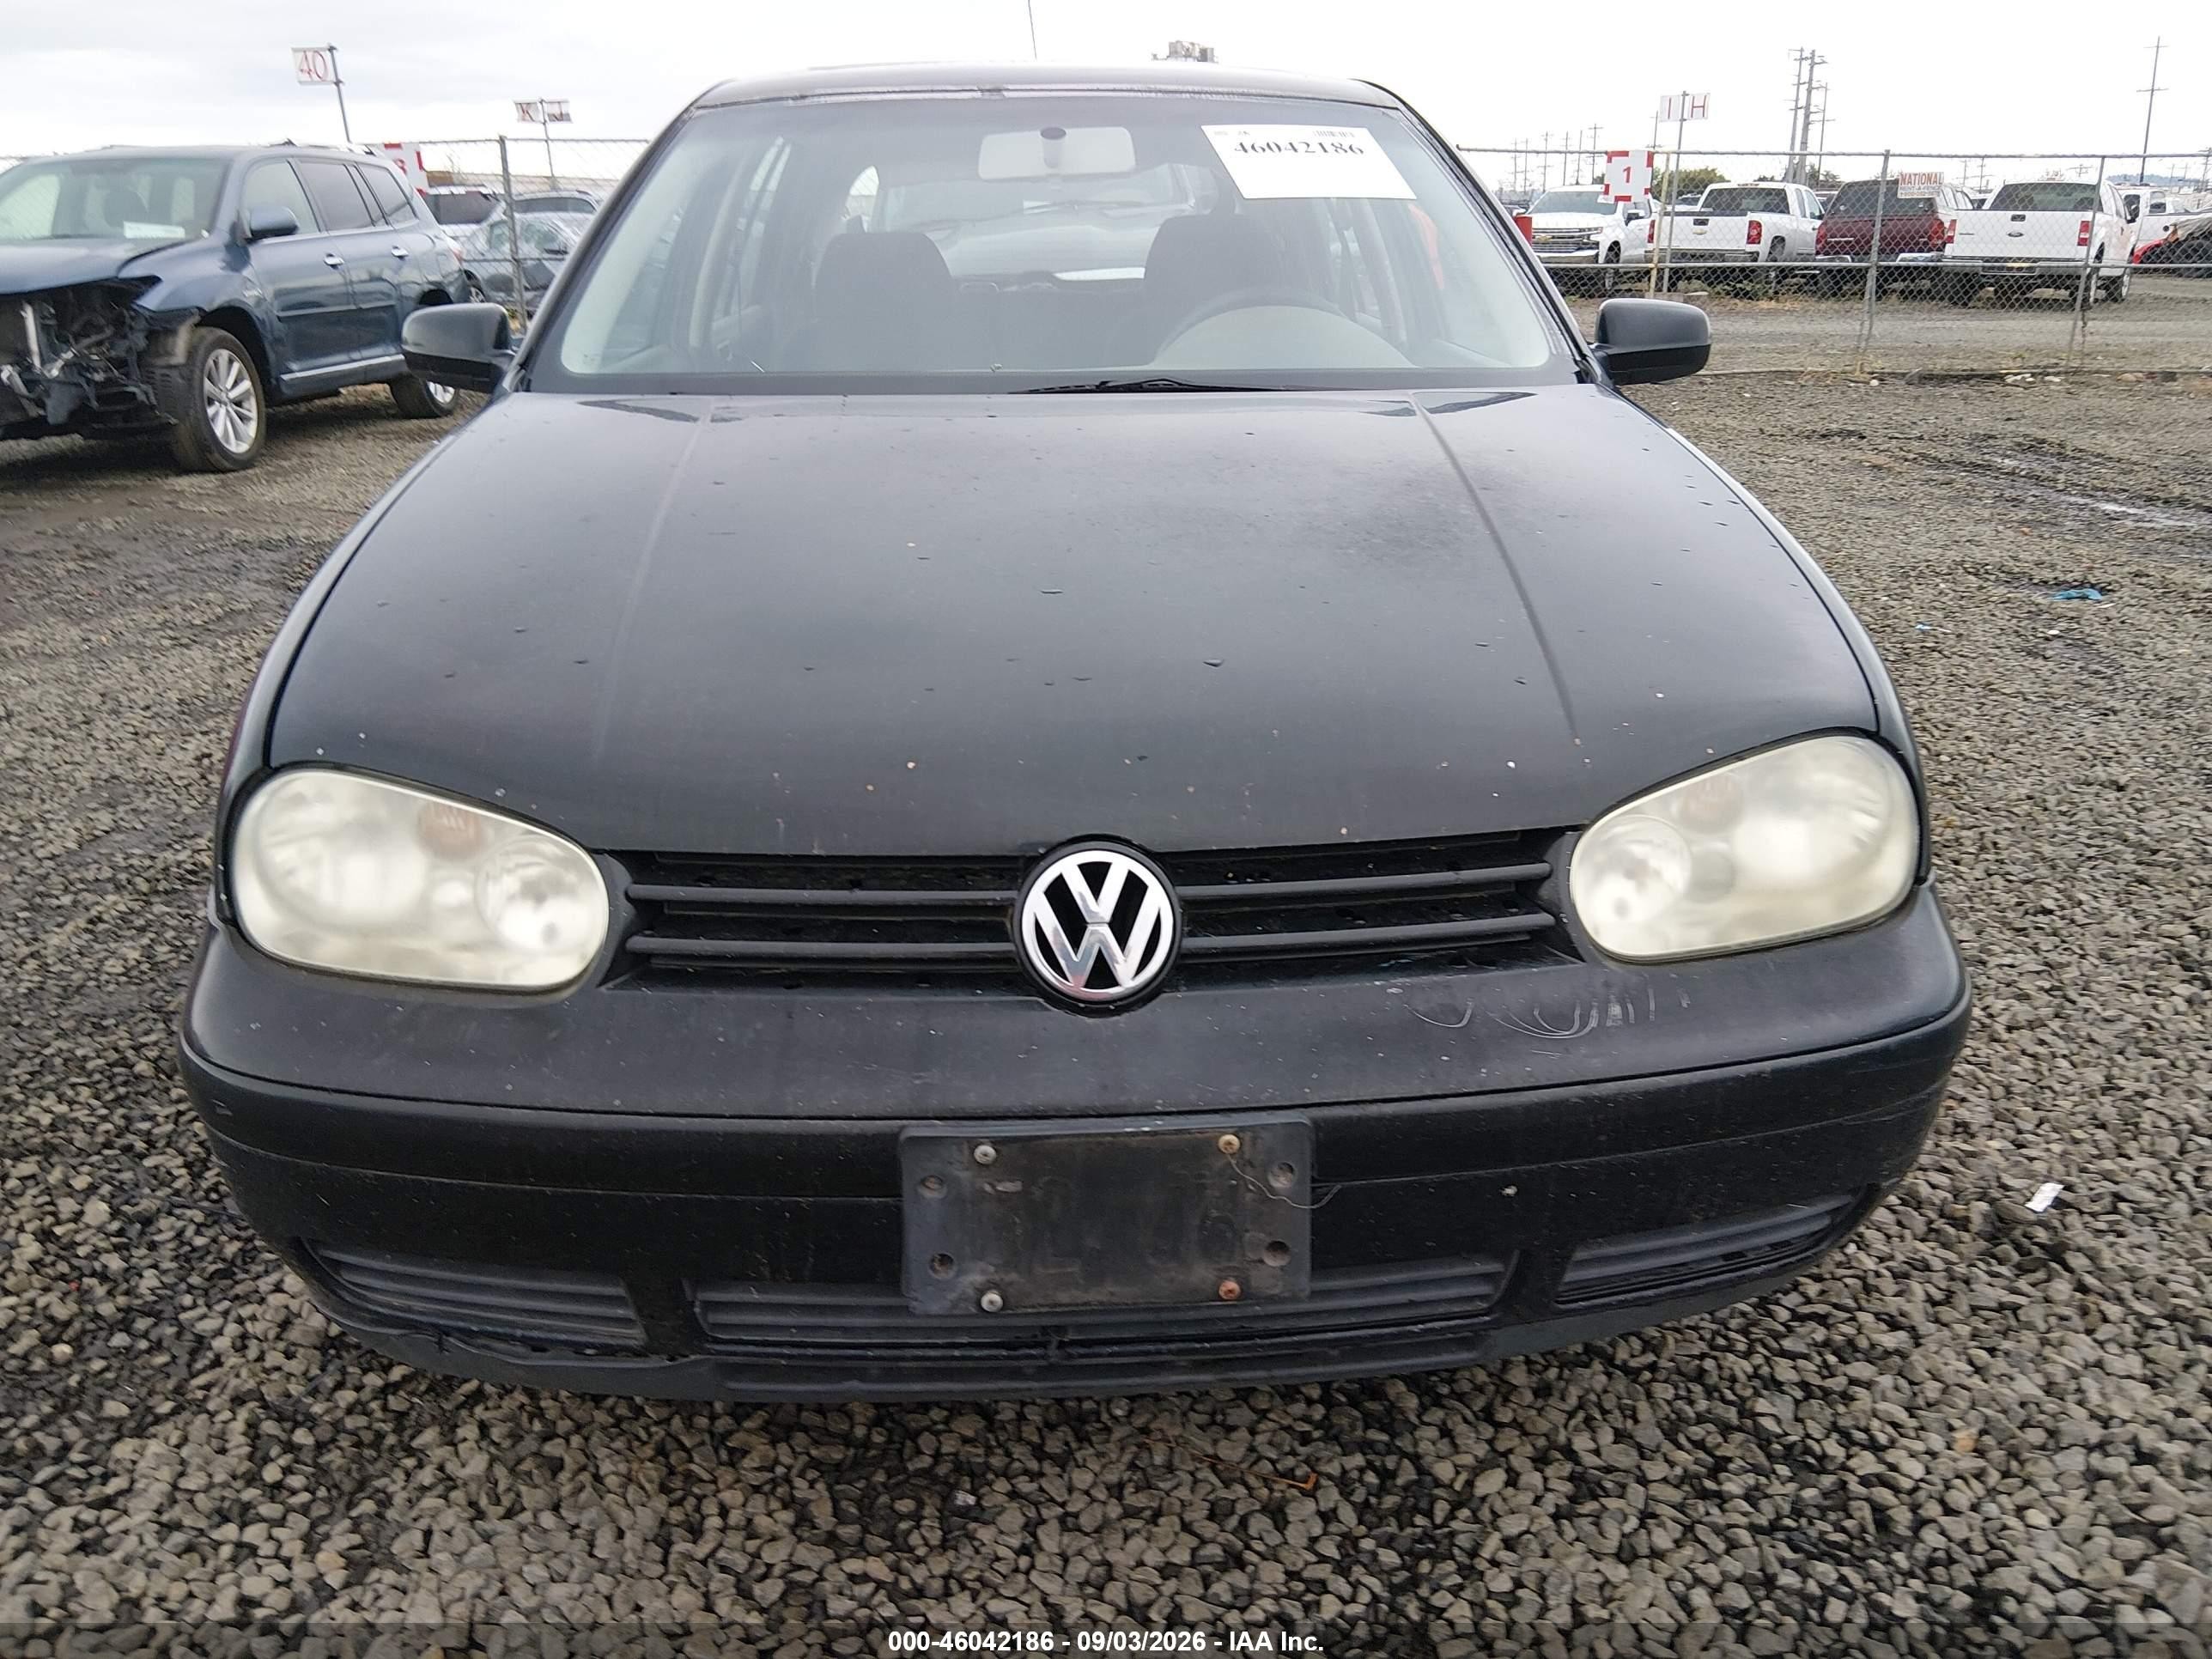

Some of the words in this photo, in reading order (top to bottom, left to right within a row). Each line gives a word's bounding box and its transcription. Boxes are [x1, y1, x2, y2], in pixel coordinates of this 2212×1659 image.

[298, 50, 328, 82] 40
[519, 102, 535, 122] K
[1689, 94, 1707, 118] H
[1234, 141, 1364, 155] 46042186
[1622, 166, 1632, 184] 1
[1899, 173, 1944, 185] NATIONAL
[1023, 851, 1173, 1000] VW
